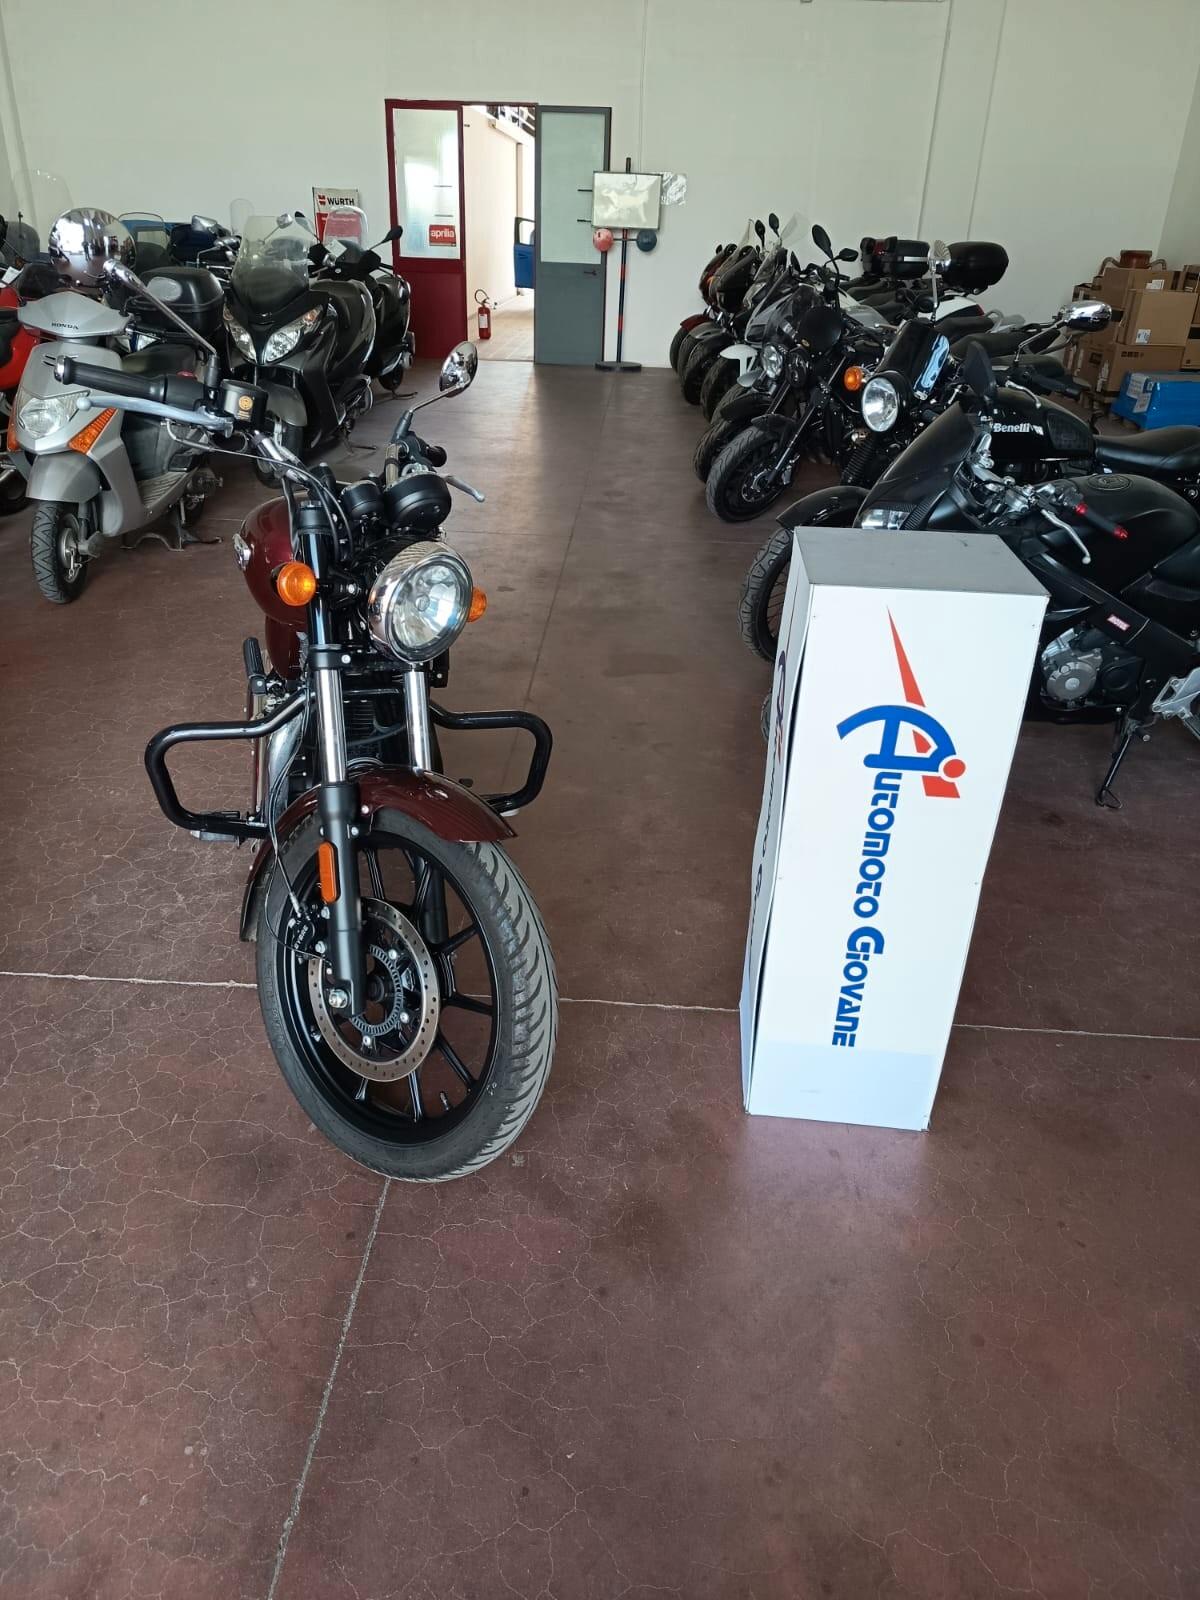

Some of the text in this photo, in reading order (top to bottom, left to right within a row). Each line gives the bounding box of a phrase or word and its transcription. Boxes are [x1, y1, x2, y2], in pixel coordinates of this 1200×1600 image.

[327, 197, 355, 206] WÜRTH
[431, 227, 455, 239] aprilia
[51, 321, 79, 330] HONDA
[993, 422, 1031, 433] Benelli
